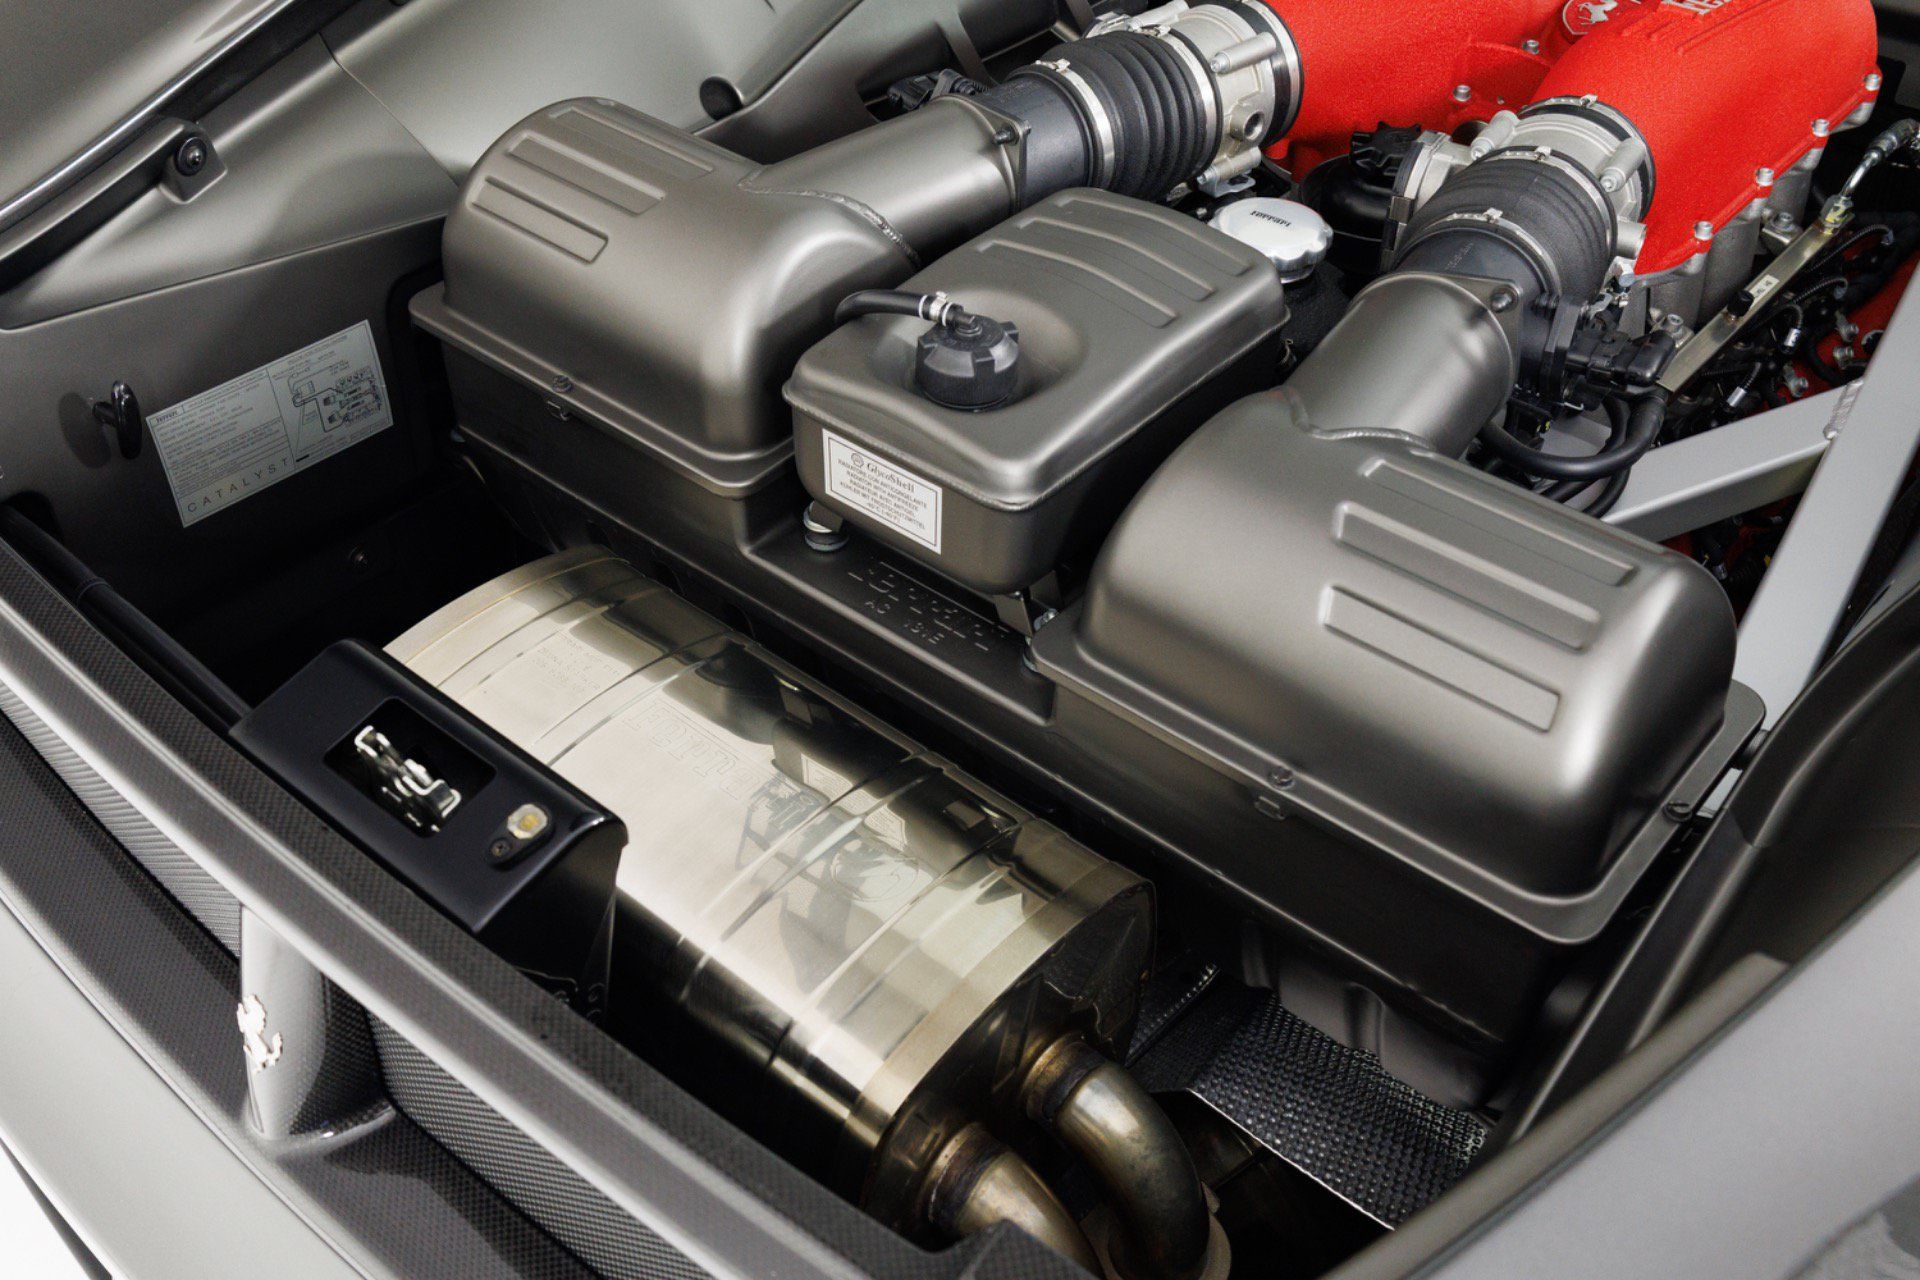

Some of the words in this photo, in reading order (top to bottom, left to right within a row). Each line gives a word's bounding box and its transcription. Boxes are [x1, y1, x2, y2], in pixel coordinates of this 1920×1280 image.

[1250, 210, 1292, 227] Ferrari
[188, 458, 288, 512] CATALYST
[867, 462, 914, 493] GlycoShell
